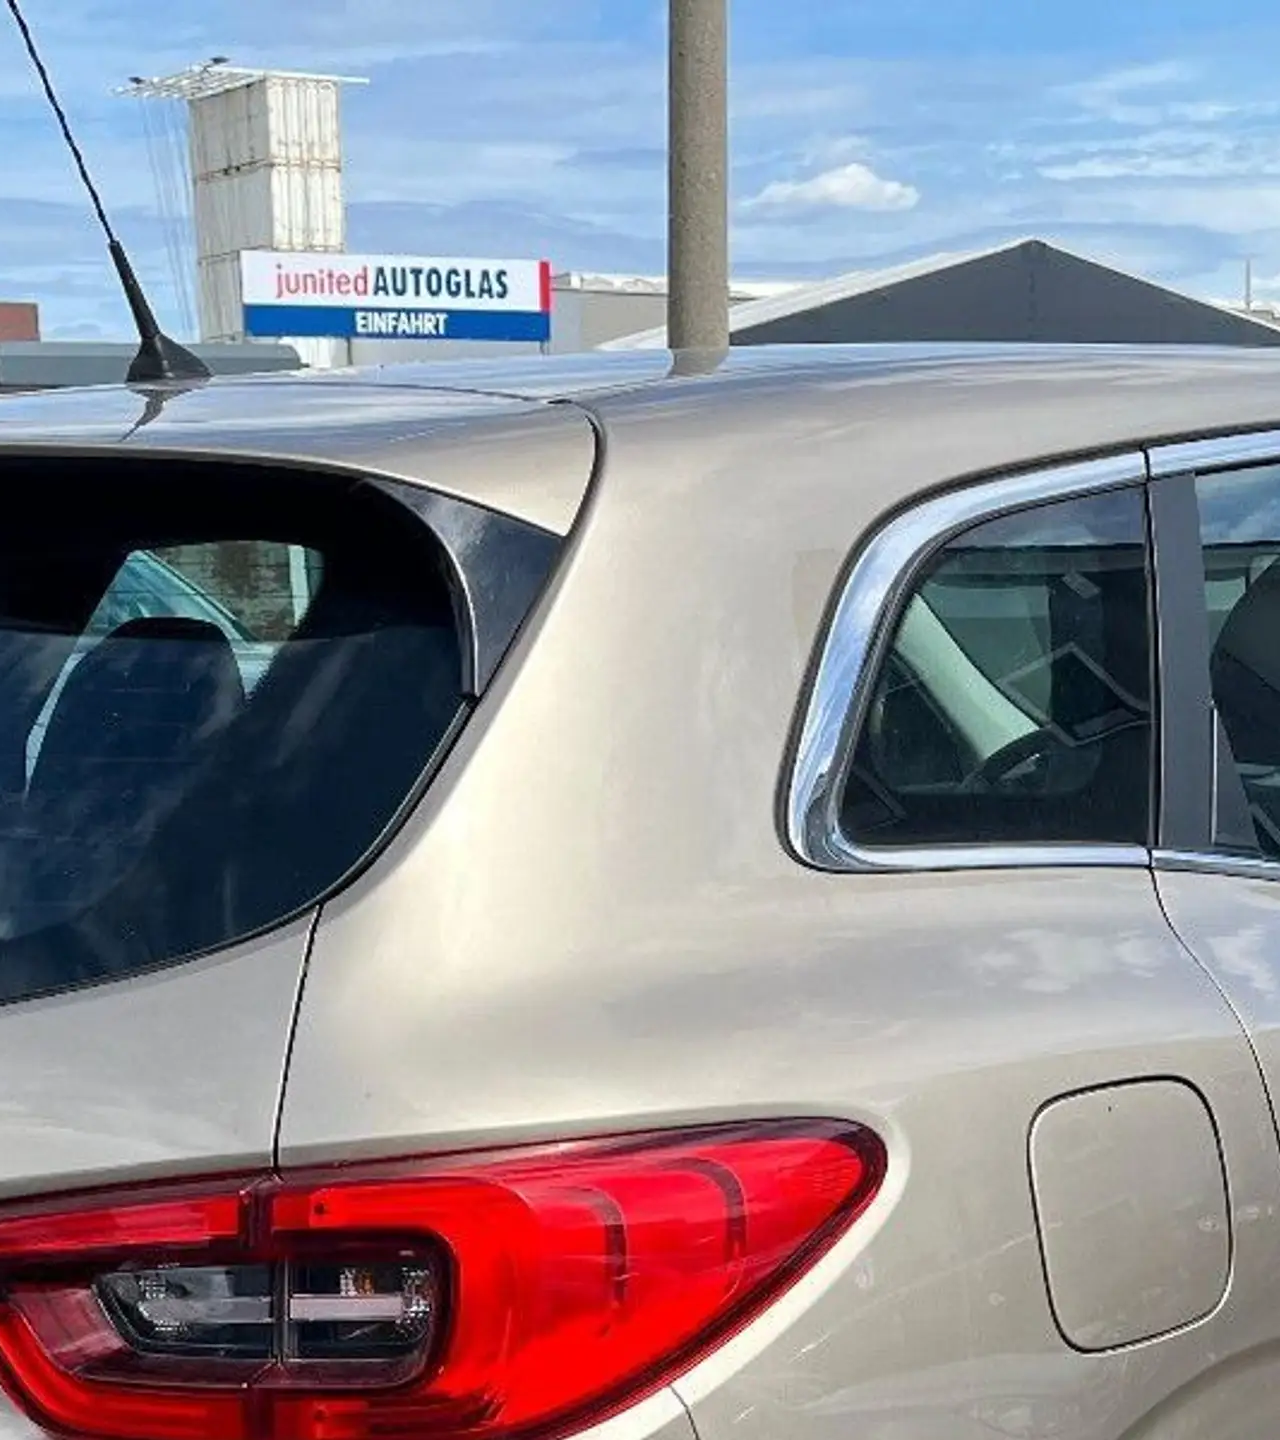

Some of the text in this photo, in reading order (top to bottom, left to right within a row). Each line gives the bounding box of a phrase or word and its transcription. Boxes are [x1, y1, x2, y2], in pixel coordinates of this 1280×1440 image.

[276, 263, 508, 299] junited AUTOGLAS
[355, 311, 448, 335] EINFAHRT
